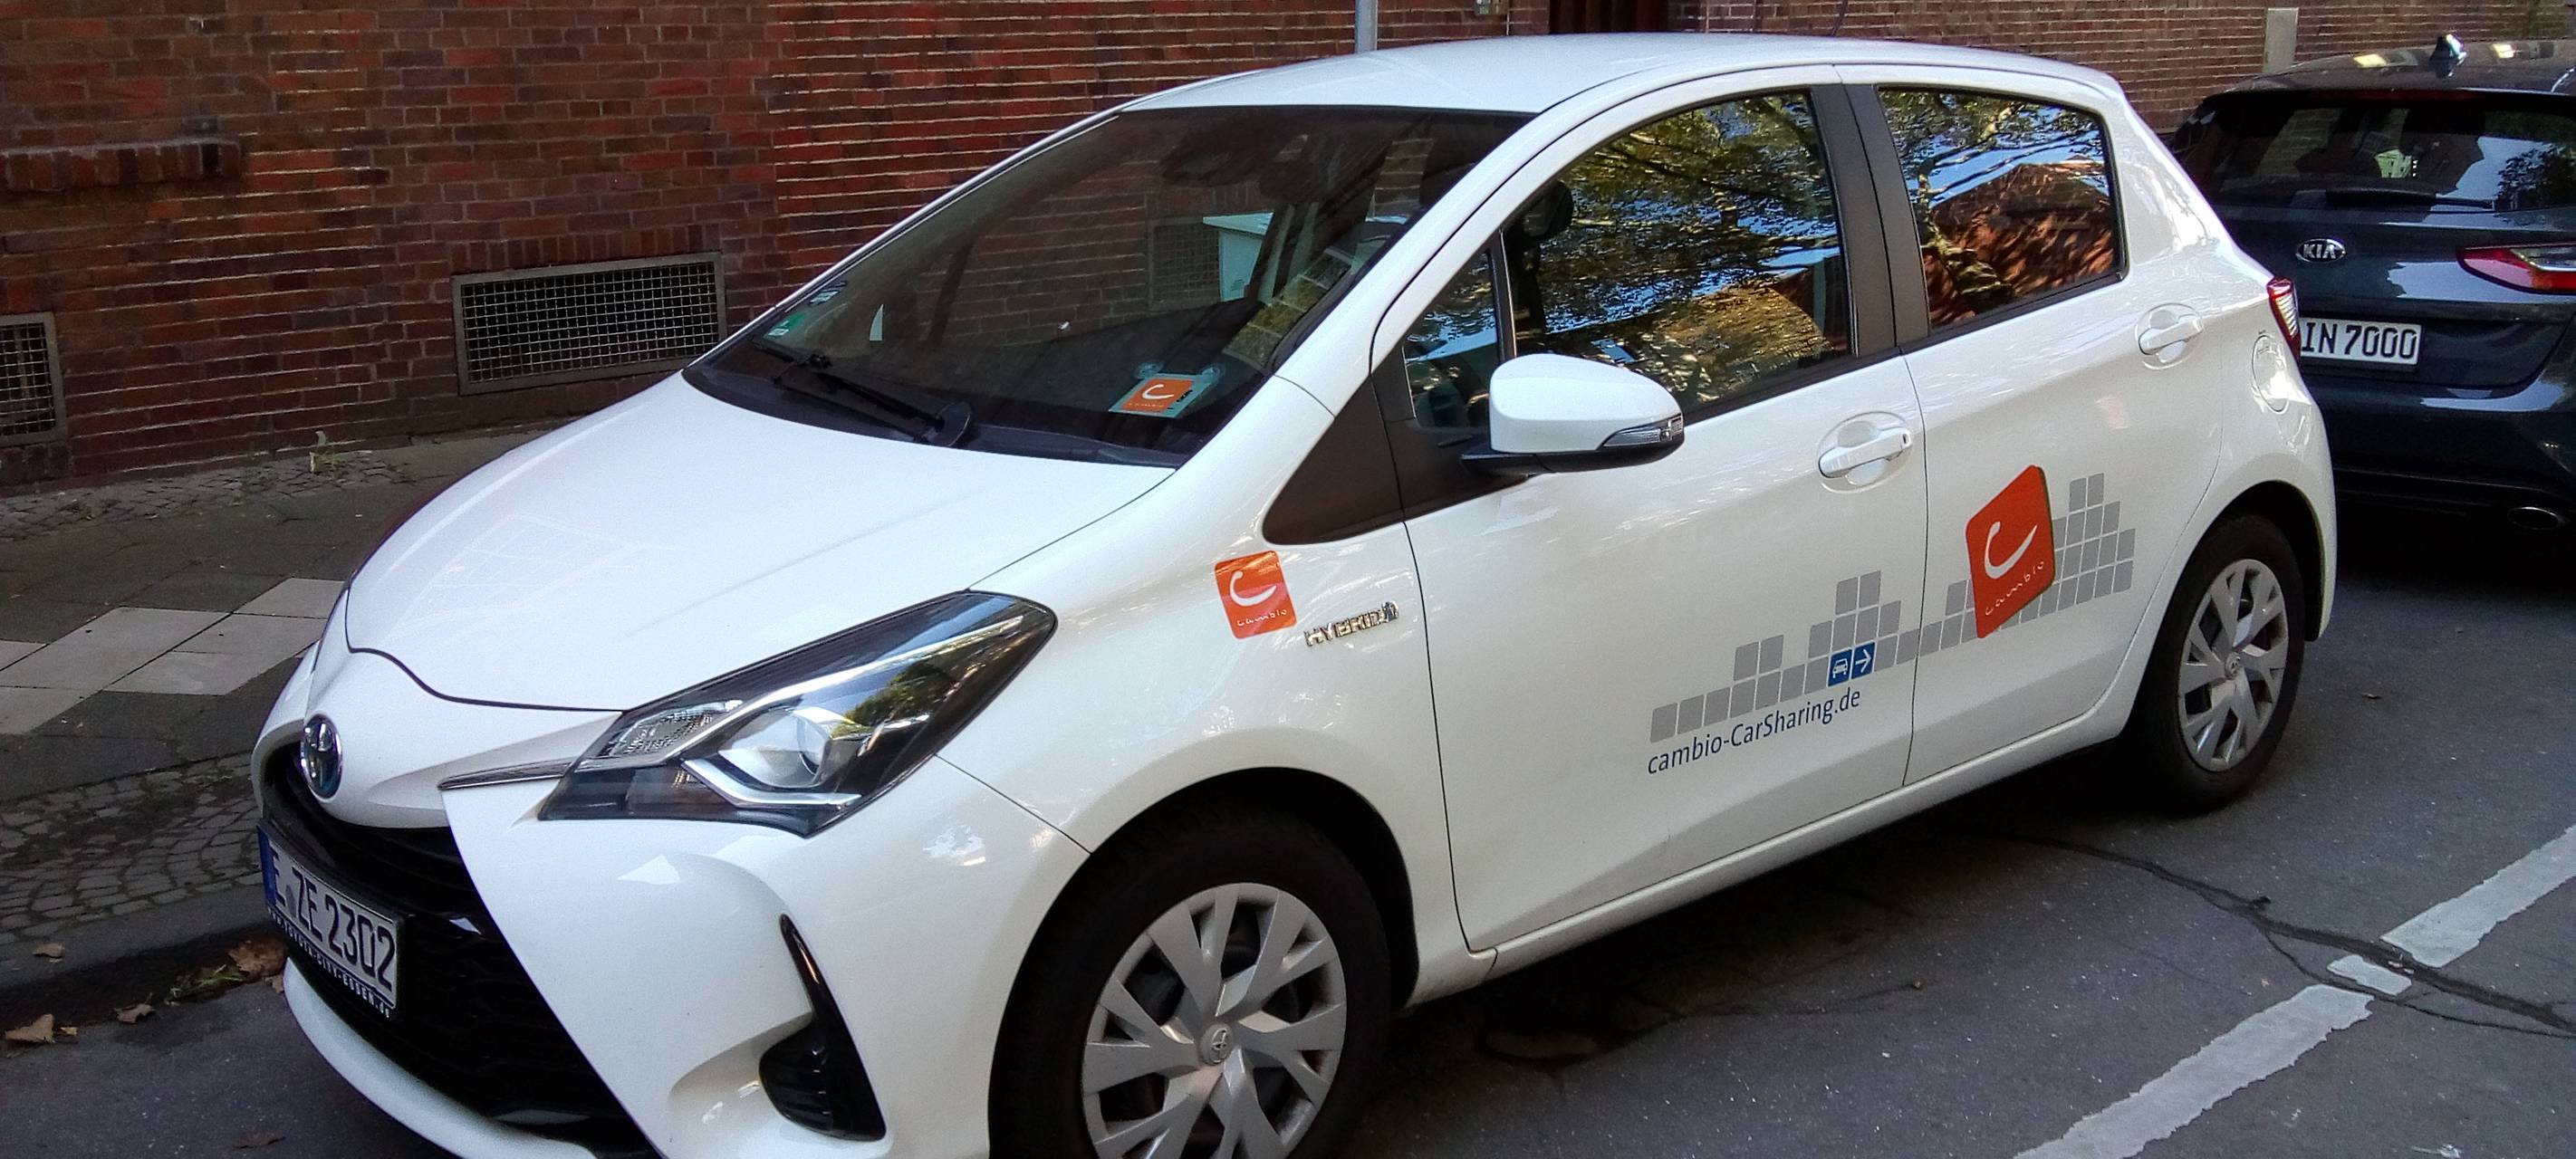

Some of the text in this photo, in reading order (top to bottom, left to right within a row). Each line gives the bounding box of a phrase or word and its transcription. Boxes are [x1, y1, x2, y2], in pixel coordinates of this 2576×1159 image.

[2302, 243, 2337, 259] KIA
[2302, 322, 2417, 359] IN 7000
[1985, 560, 2045, 617] cambio
[1236, 608, 1288, 627] cambio
[1304, 609, 1381, 647] HYBRID
[1647, 686, 1861, 775] cambio-CarSharing.de
[268, 844, 395, 992] E ZE 2302
